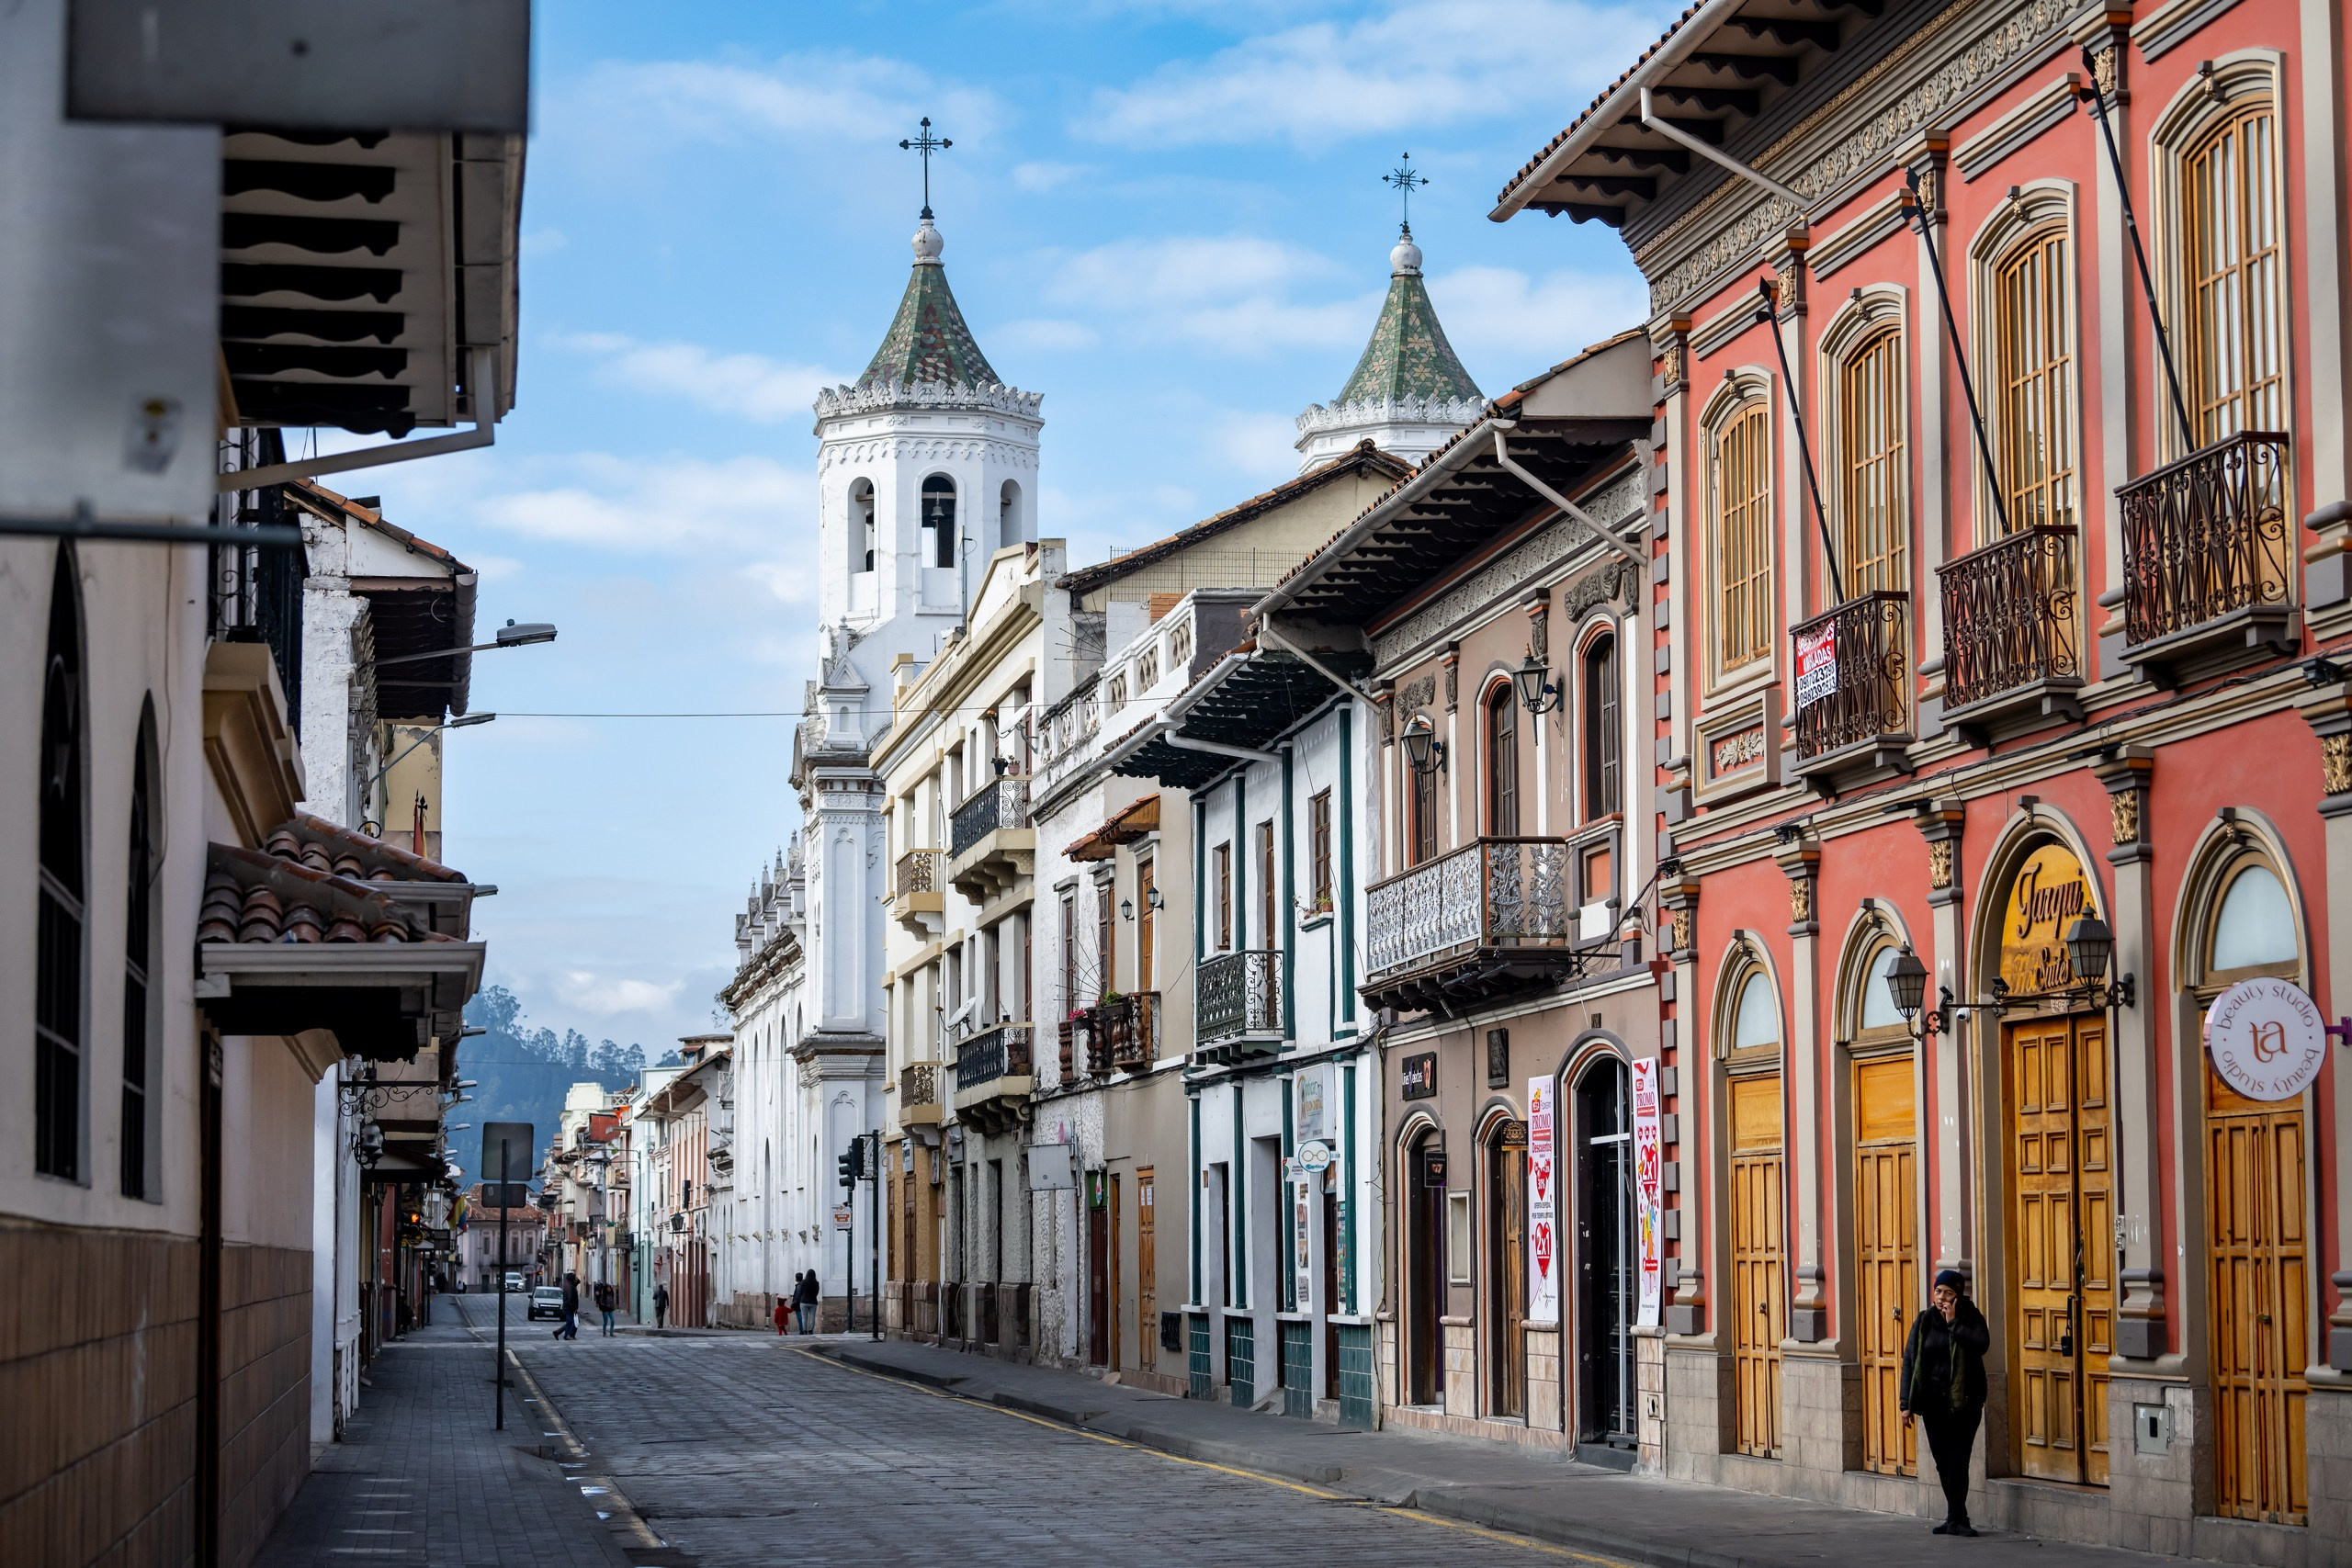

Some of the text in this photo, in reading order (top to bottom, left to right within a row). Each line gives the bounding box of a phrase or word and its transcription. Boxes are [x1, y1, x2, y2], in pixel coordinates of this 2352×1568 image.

[2017, 862, 2084, 940] Tarqui
[2216, 985, 2314, 1030] beauty studio
[2249, 1021, 2289, 1063] ta
[2222, 1048, 2321, 1093] beauty studio
[1636, 1091, 1656, 1107] PROMO
[1532, 1113, 1552, 1130] PROMO
[1532, 1142, 1553, 1154] Descuentos
[1643, 1153, 1657, 1180] 2x1
[1537, 1231, 1550, 1256] 2x1
